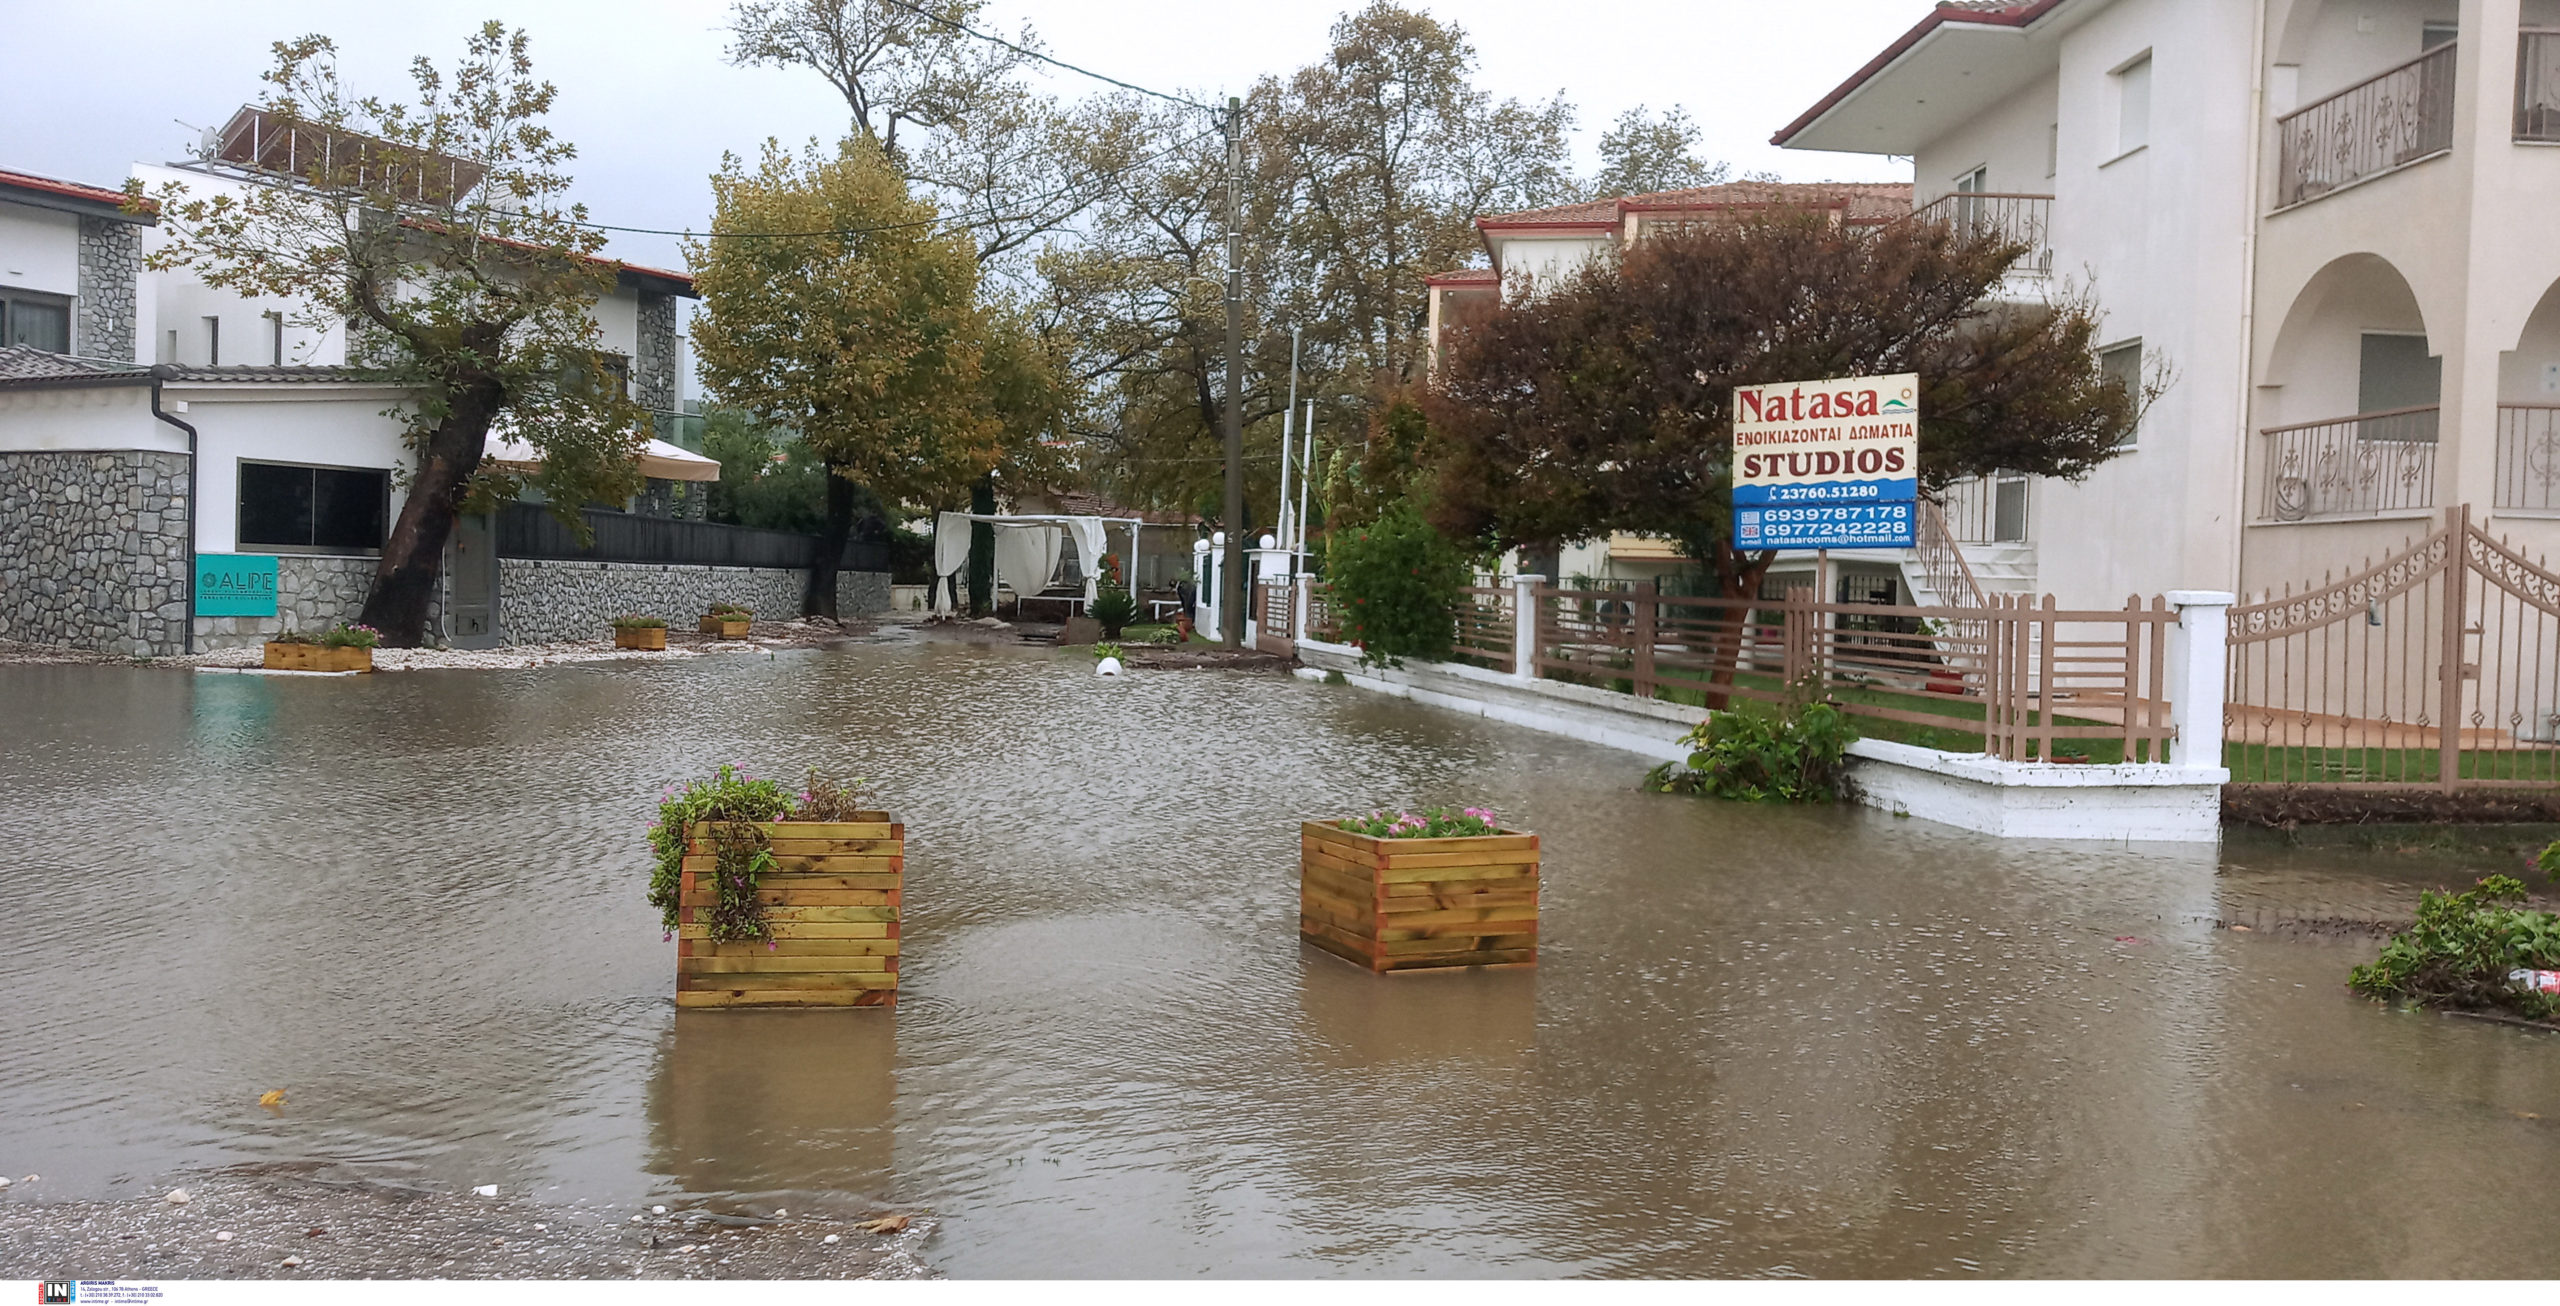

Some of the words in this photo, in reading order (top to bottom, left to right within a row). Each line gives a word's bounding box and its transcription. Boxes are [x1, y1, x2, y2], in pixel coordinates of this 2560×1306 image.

[1738, 387, 1880, 424] Natasa
[1736, 427, 1841, 446] ΕΝΟΙΚΙΑΖΟΝΤΑΙ
[1849, 423, 1913, 440] ΔΩΜΑΤΙΑ
[1743, 447, 1905, 478] STUDIOS
[1780, 485, 1878, 499] 23760.51280
[1764, 506, 1907, 521] 6939787178
[1764, 521, 1907, 536] 6977242228
[1767, 533, 1910, 545] natasarooms@hotmail.com
[219, 572, 273, 590] ALPE
